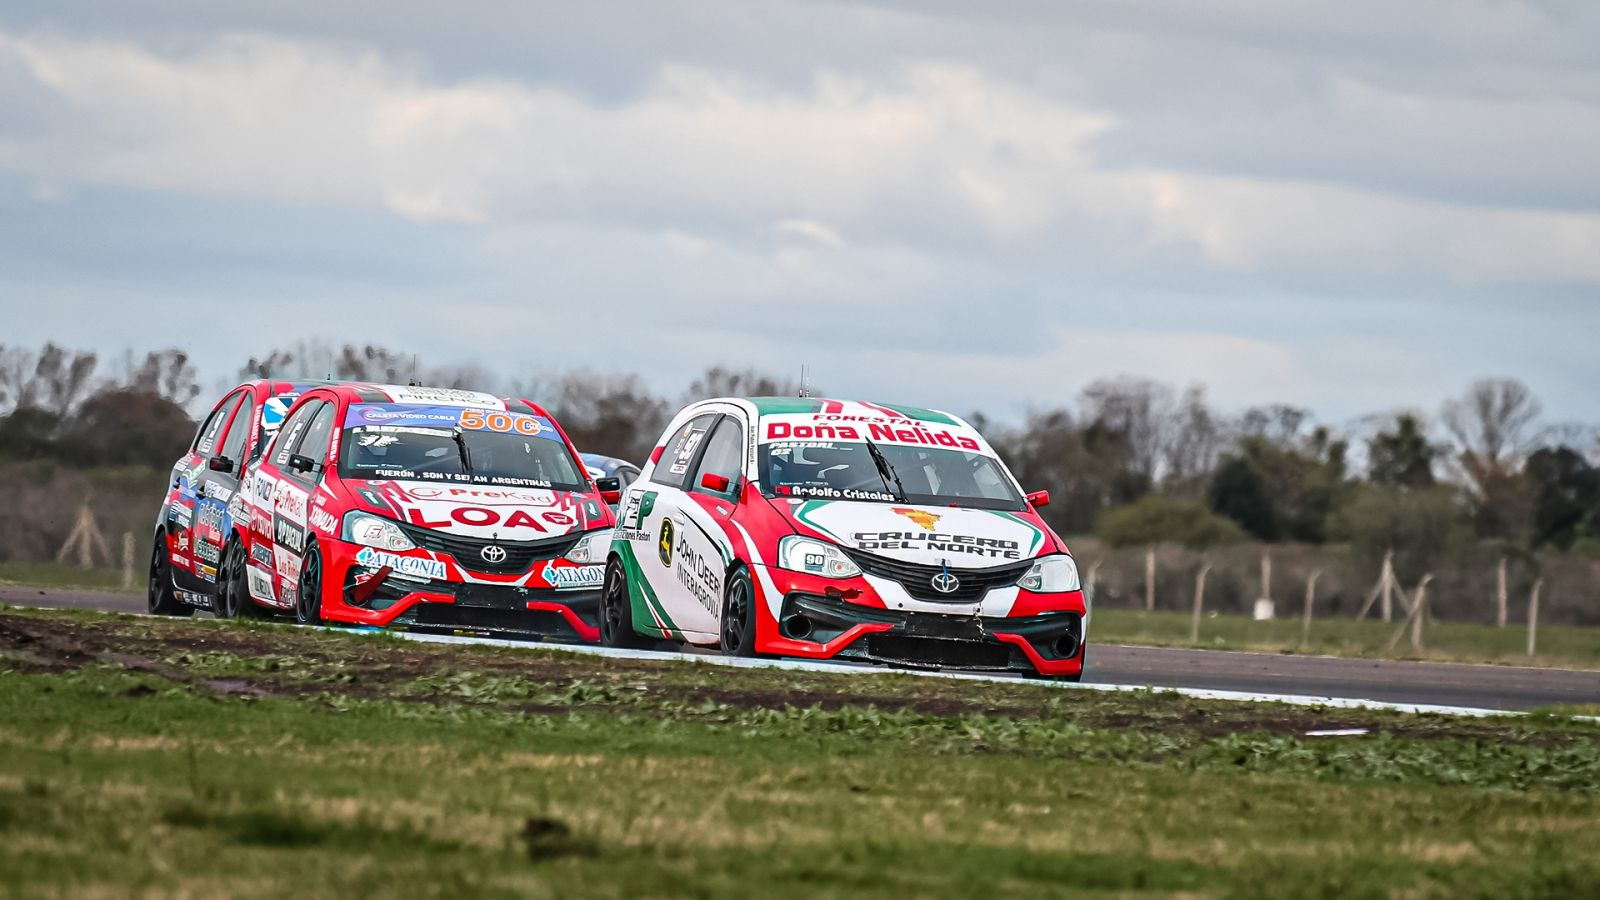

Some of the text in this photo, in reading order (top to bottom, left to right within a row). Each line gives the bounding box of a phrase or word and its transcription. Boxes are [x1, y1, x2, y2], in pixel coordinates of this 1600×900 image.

[366, 412, 401, 420] CALETA
[428, 414, 456, 422] CABLE
[812, 415, 926, 427] FORESTAL
[767, 423, 981, 451] Doña Nelida
[422, 472, 444, 480] SON
[491, 476, 552, 488] ARGENTINAS
[448, 488, 552, 504] PreKad
[843, 489, 895, 501] Cristales
[854, 532, 1019, 550] CRUCERO
[676, 531, 697, 572] JOHN
[858, 541, 1021, 560] DEL NORTE
[805, 554, 825, 565] 90
